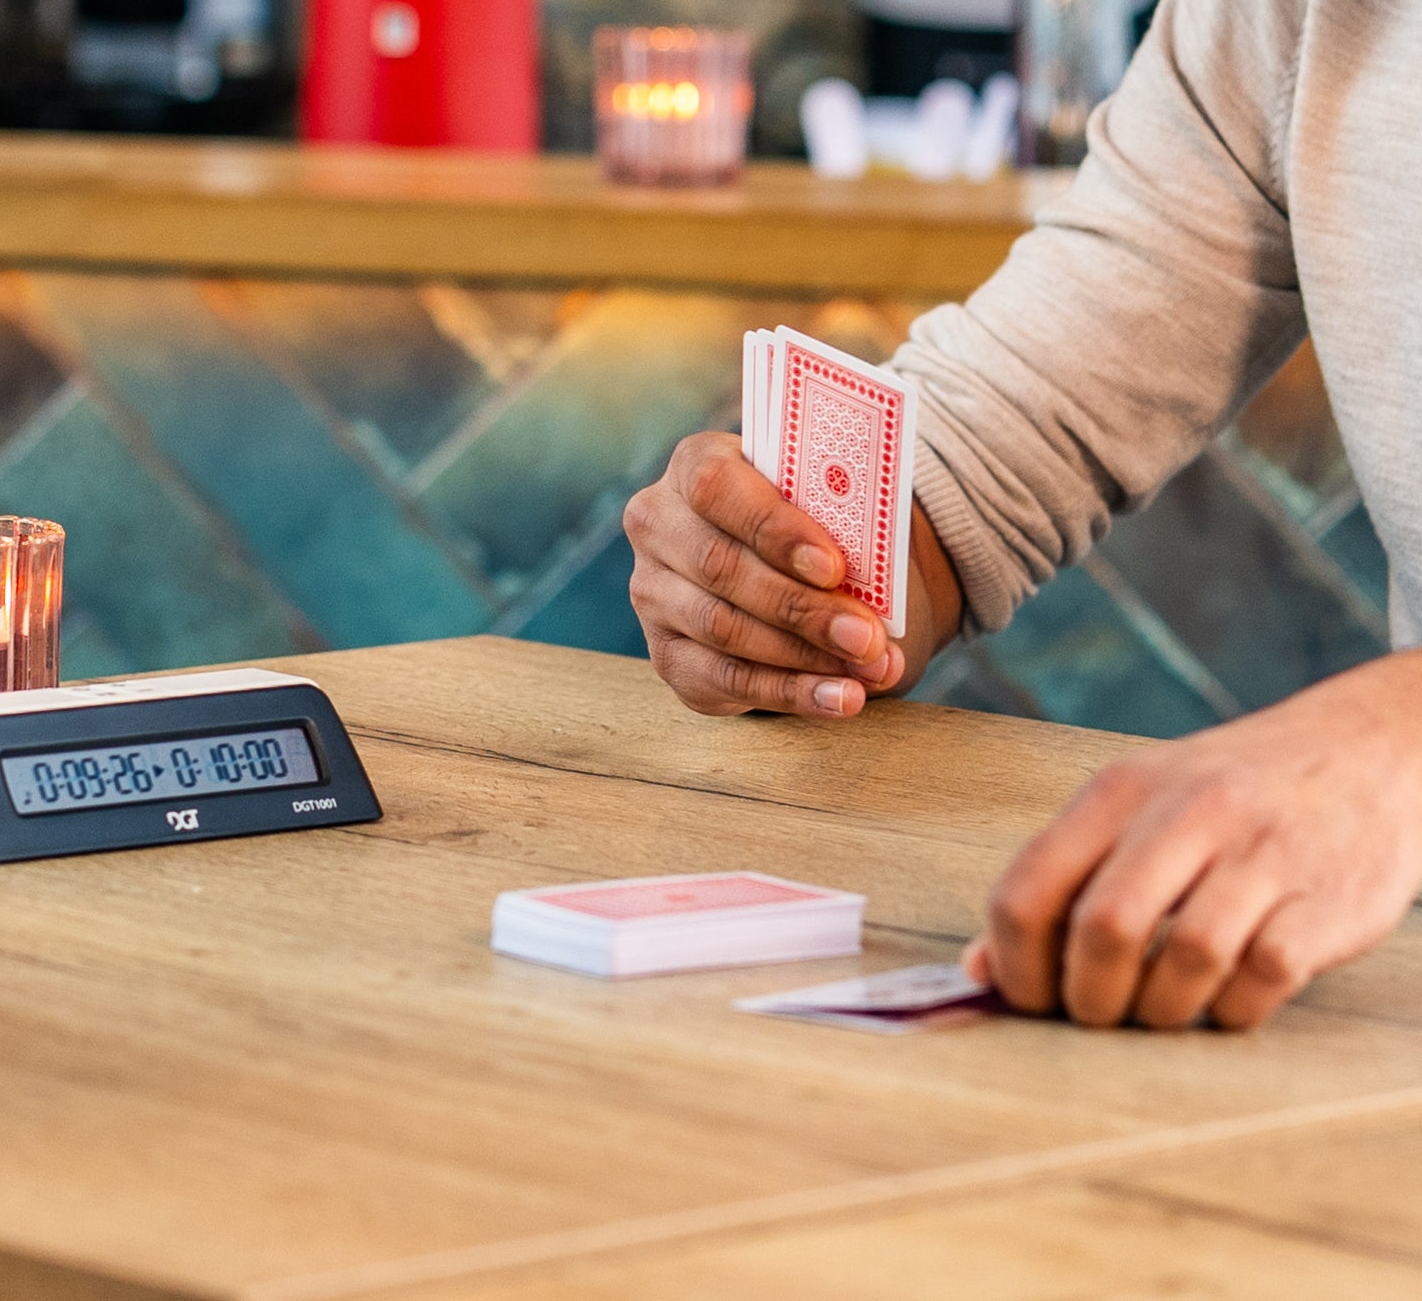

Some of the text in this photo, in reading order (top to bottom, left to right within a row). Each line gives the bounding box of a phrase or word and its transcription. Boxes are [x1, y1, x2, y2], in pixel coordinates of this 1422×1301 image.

[33, 738, 288, 803] 0:09:26 0:10:00
[291, 797, 337, 813] DGT1001
[165, 808, 199, 831] DGT
